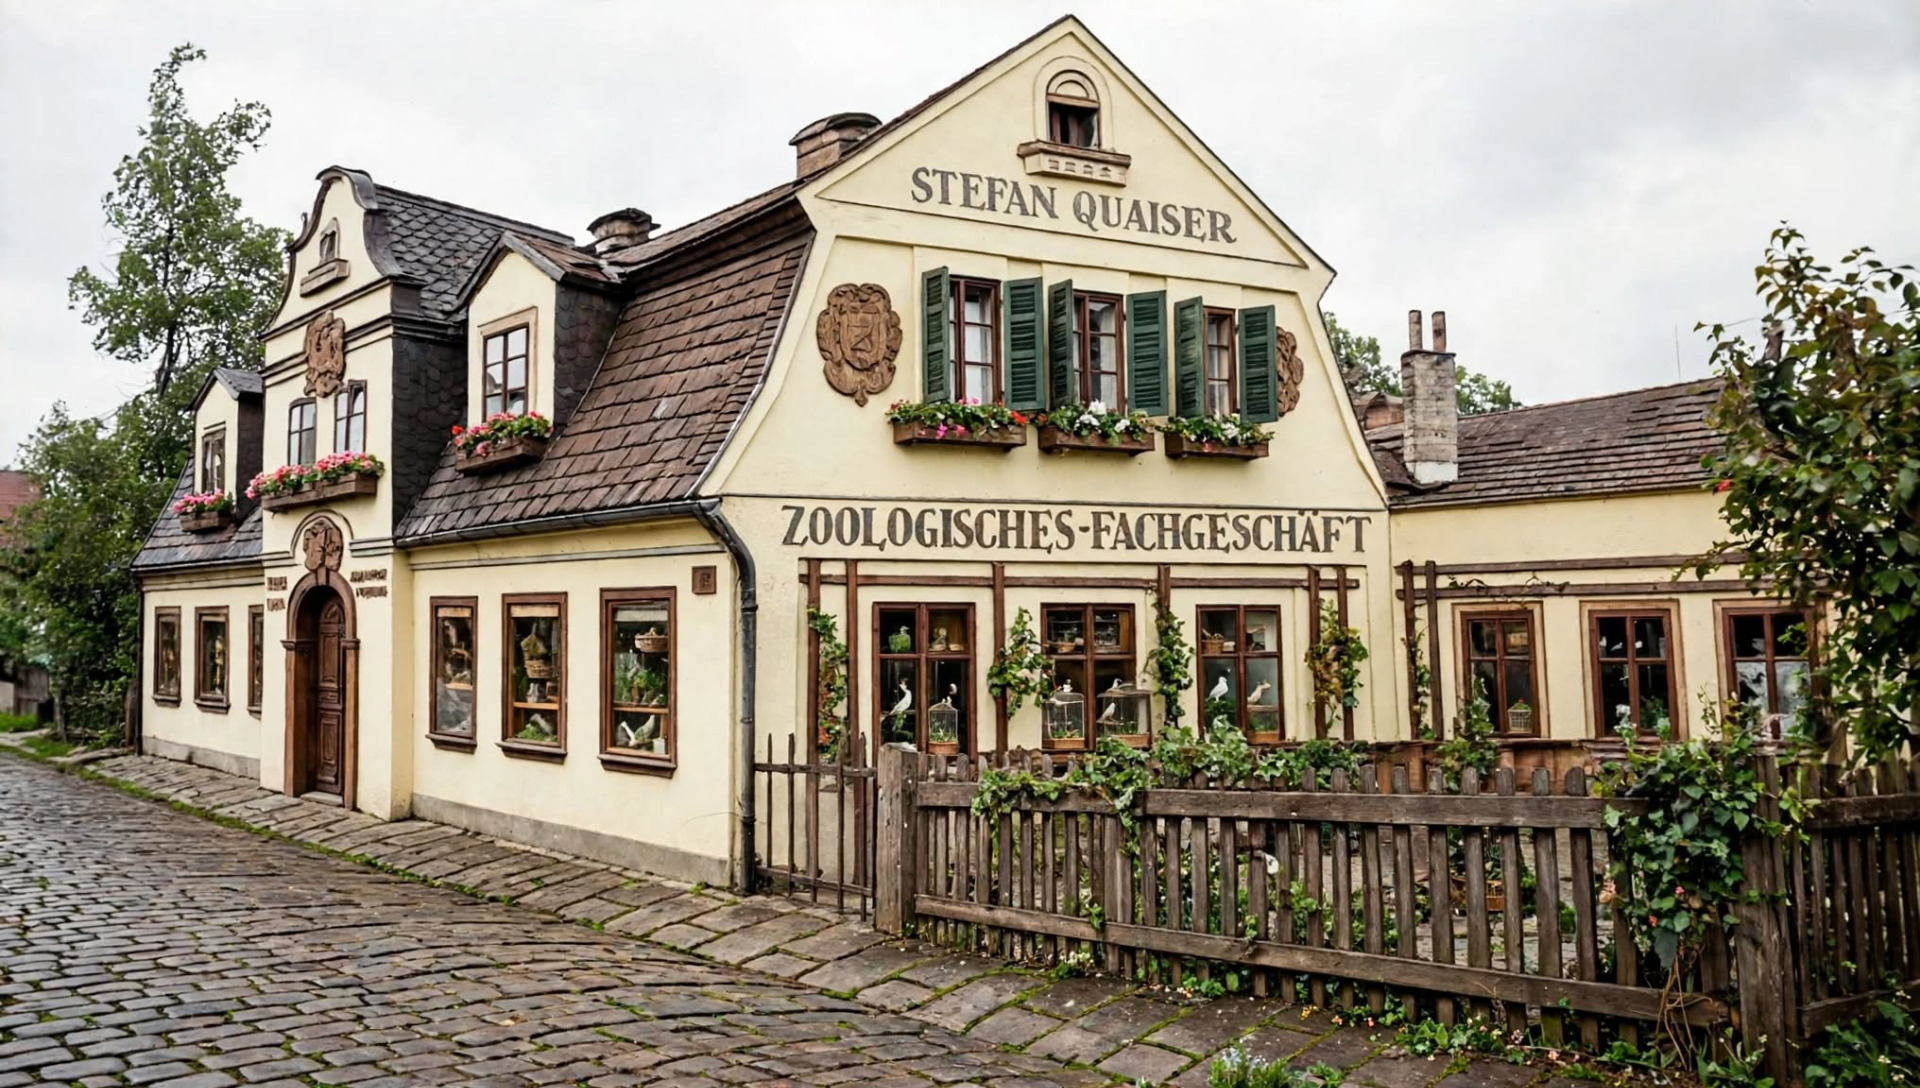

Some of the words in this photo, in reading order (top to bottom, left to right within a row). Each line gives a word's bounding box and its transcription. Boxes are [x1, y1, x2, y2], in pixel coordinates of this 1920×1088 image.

[911, 167, 1059, 219] STEFAN
[1073, 190, 1236, 243] QUAISER
[781, 506, 1372, 554] ZOOLOGISCHES-FACHGESCHÄFT
